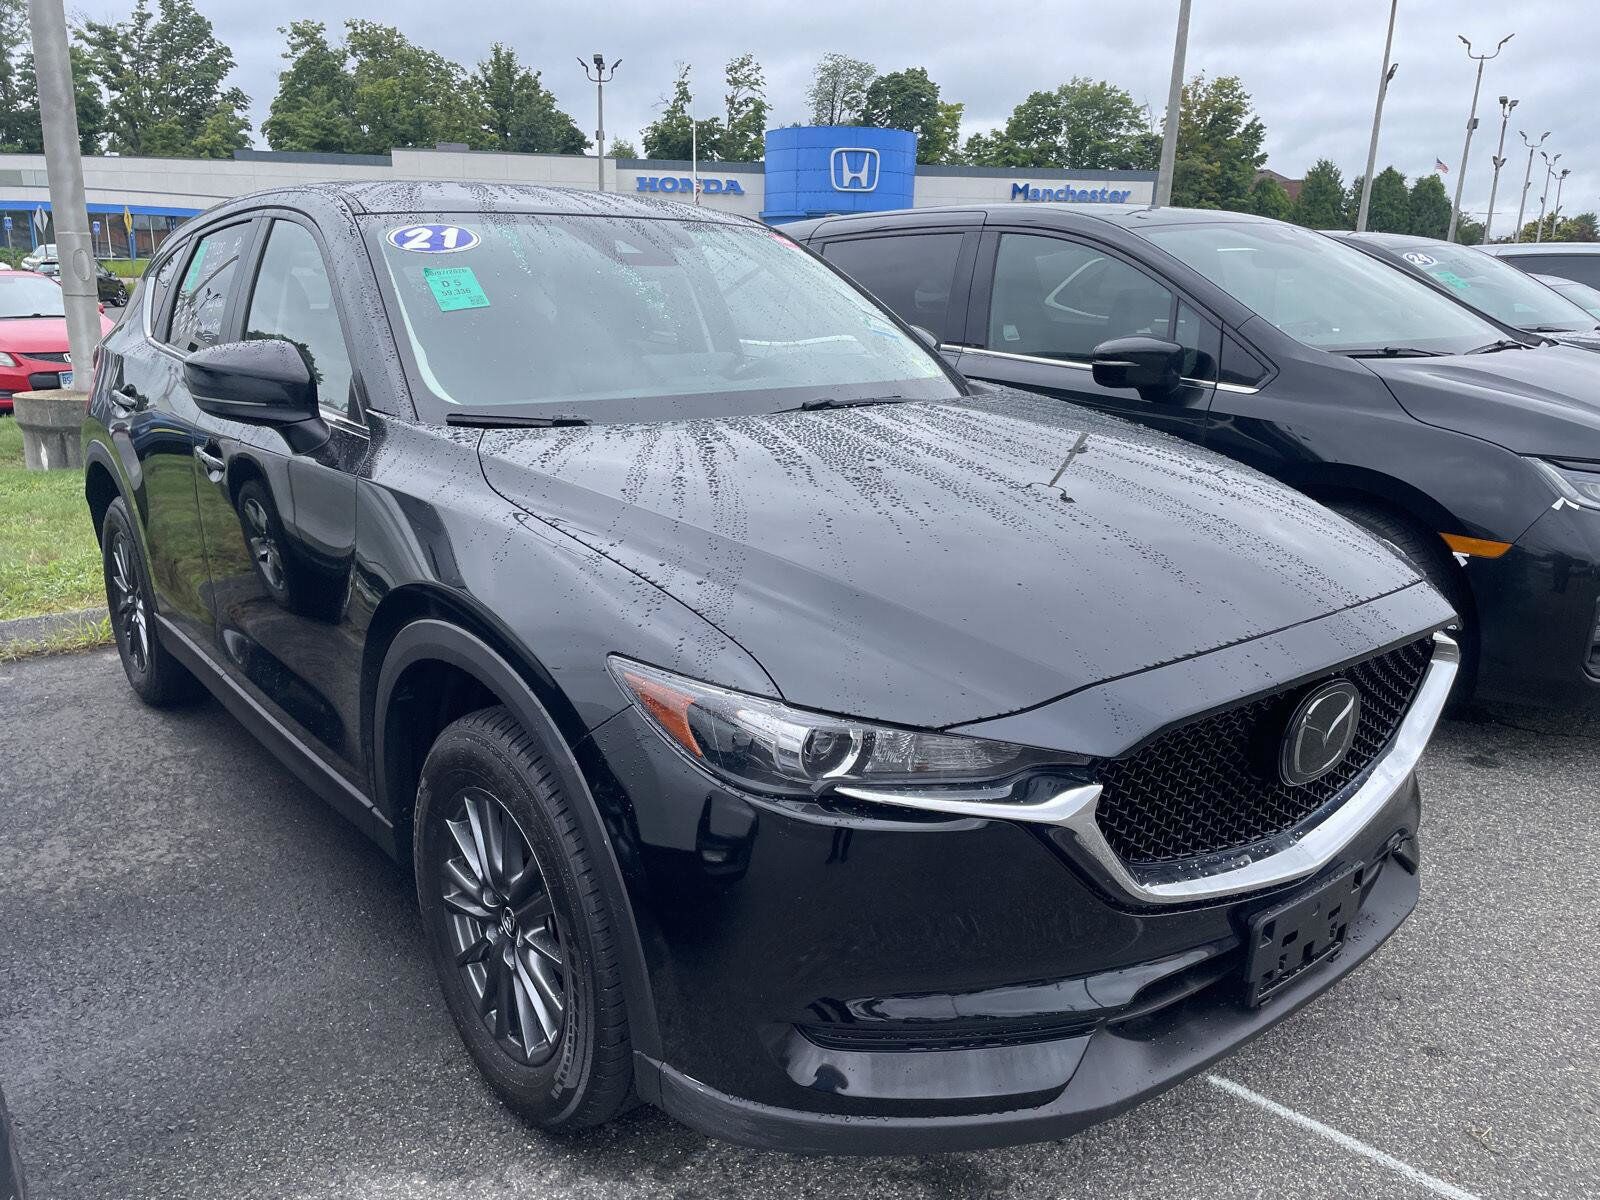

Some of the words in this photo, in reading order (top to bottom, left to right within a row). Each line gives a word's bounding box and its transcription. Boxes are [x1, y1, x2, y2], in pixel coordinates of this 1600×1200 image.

[636, 176, 745, 195] HONDA
[1011, 182, 1132, 204] Manchester
[402, 227, 459, 249] 21
